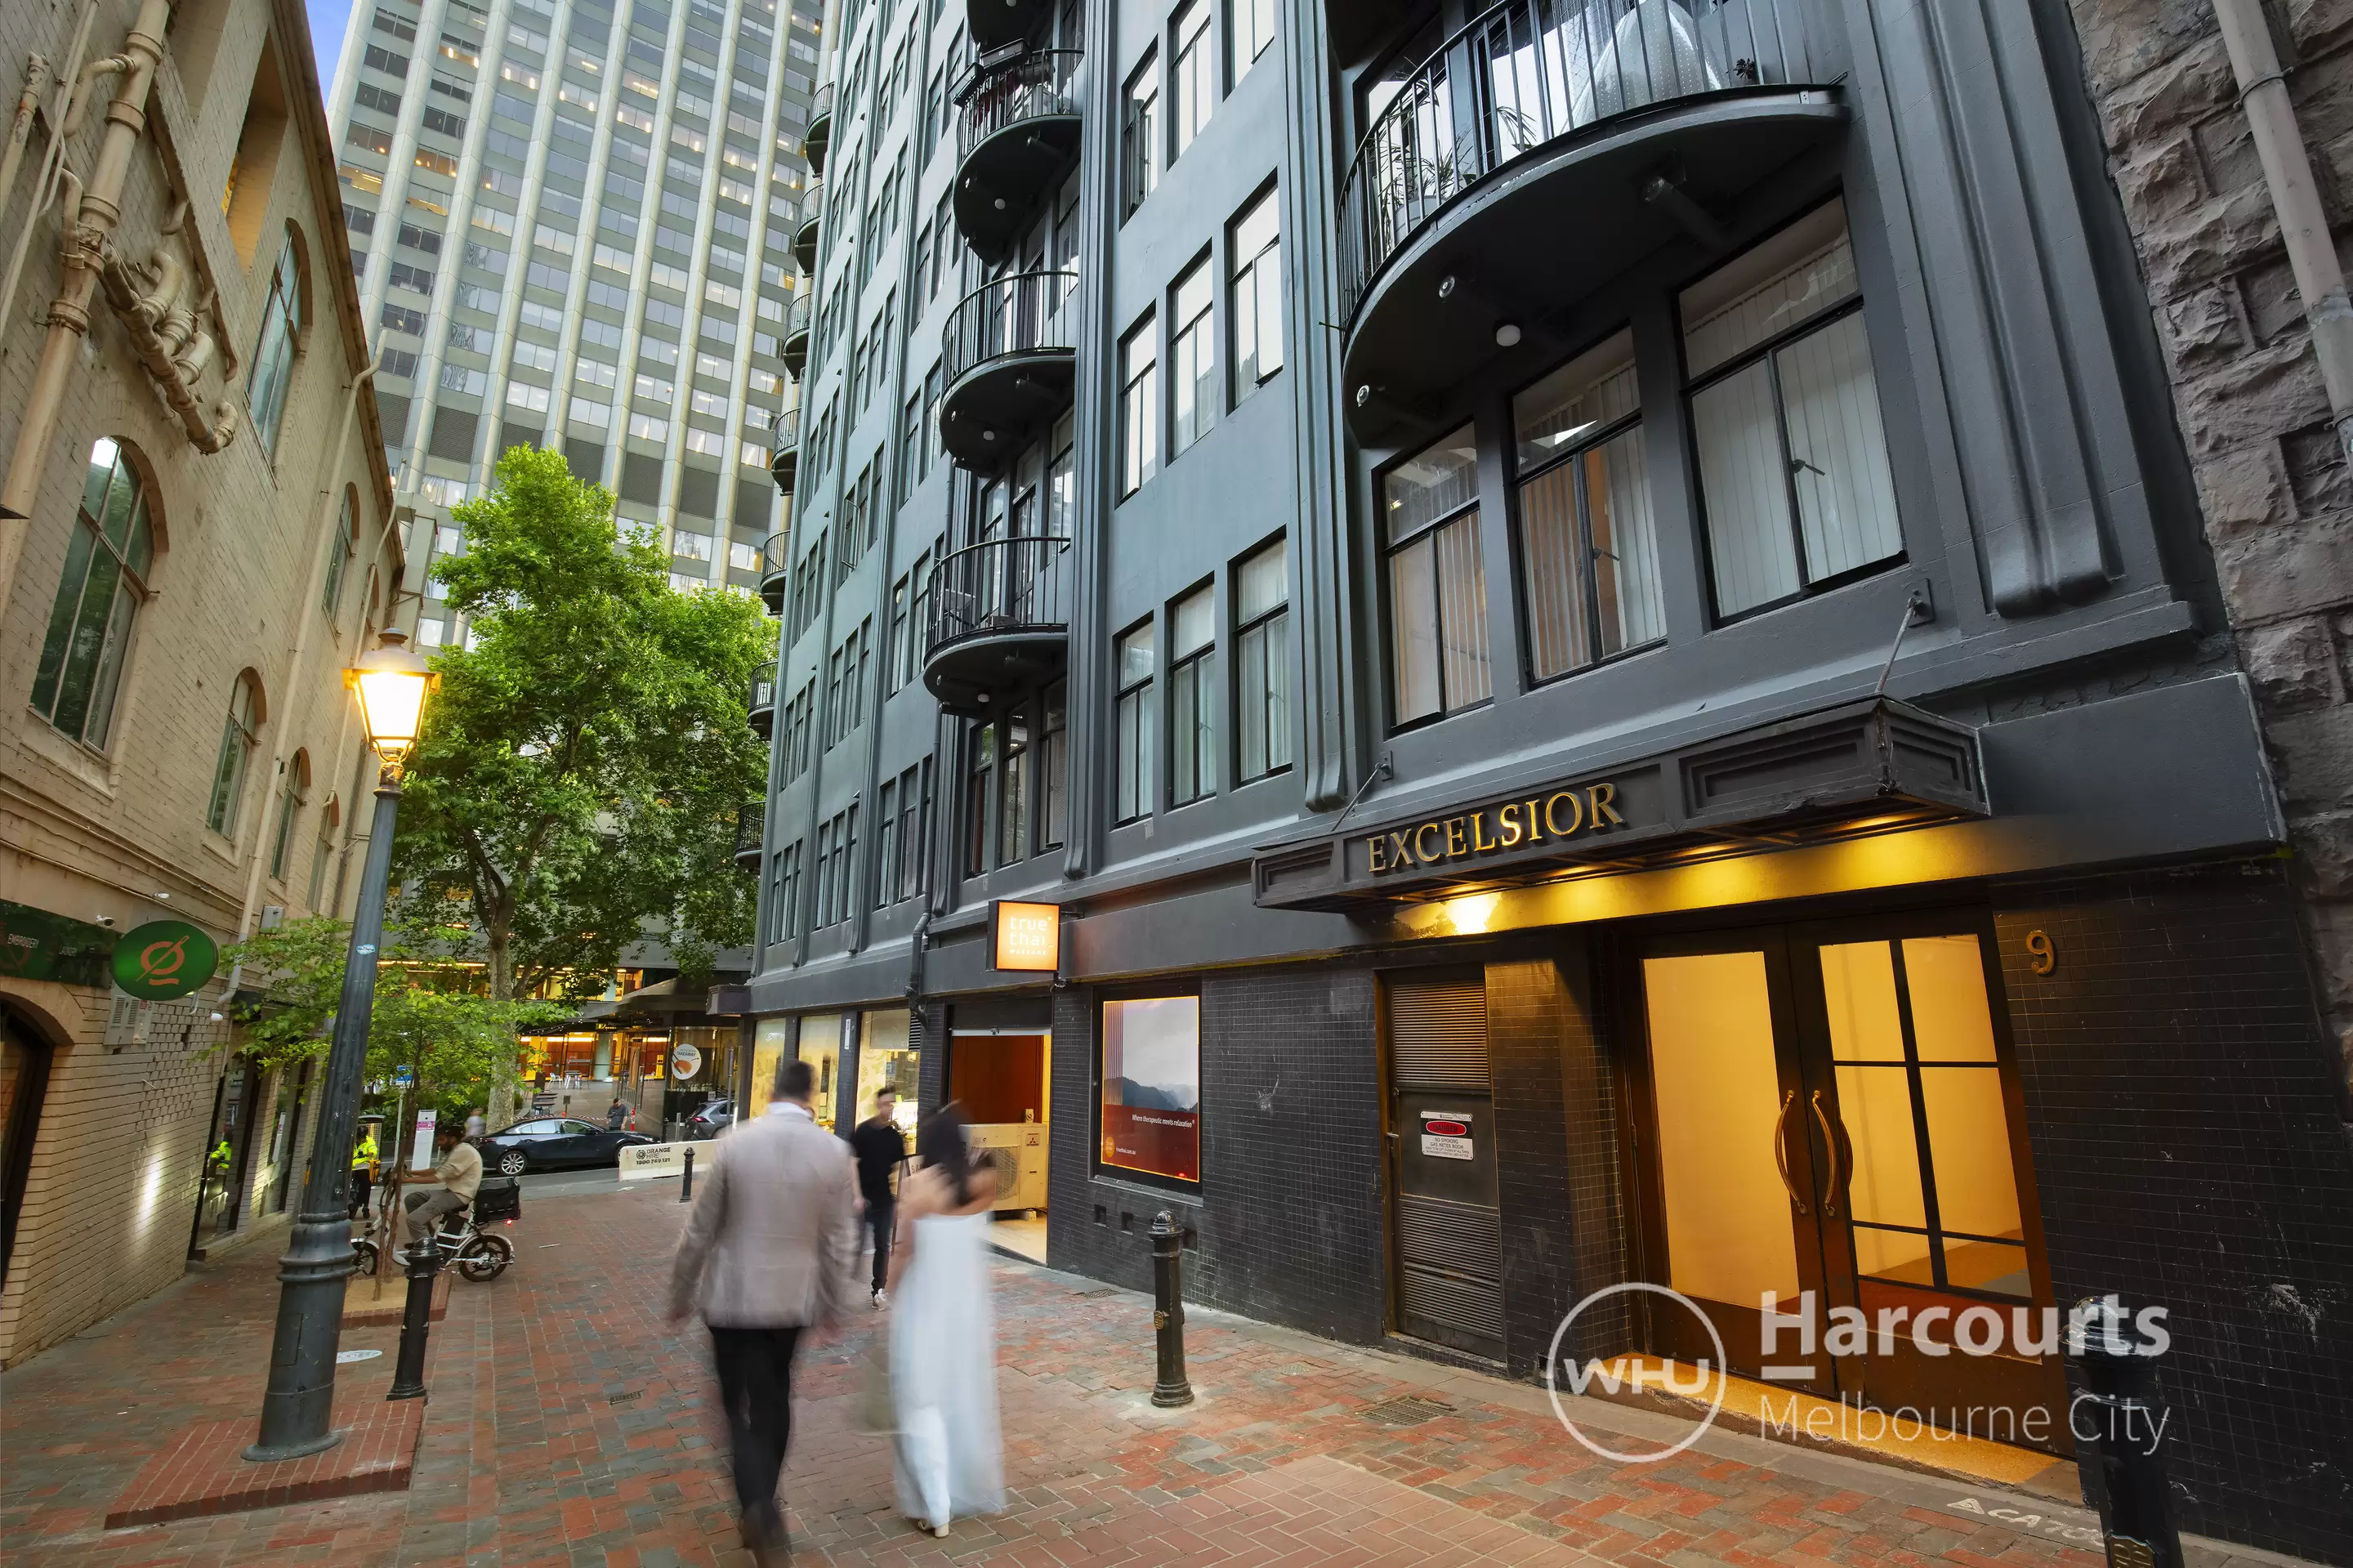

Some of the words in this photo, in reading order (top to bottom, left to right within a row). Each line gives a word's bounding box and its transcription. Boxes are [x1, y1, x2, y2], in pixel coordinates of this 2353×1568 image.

[1366, 783, 1627, 873] EXCELSIOR
[1010, 916, 1047, 931] true
[1010, 931, 1046, 946] thai
[2026, 930, 2054, 975] 9
[1132, 1114, 1143, 1122] Where
[1143, 1115, 1163, 1125] therapeutic
[1174, 1119, 1193, 1128] relaxation
[1434, 1124, 1458, 1132] DANGER
